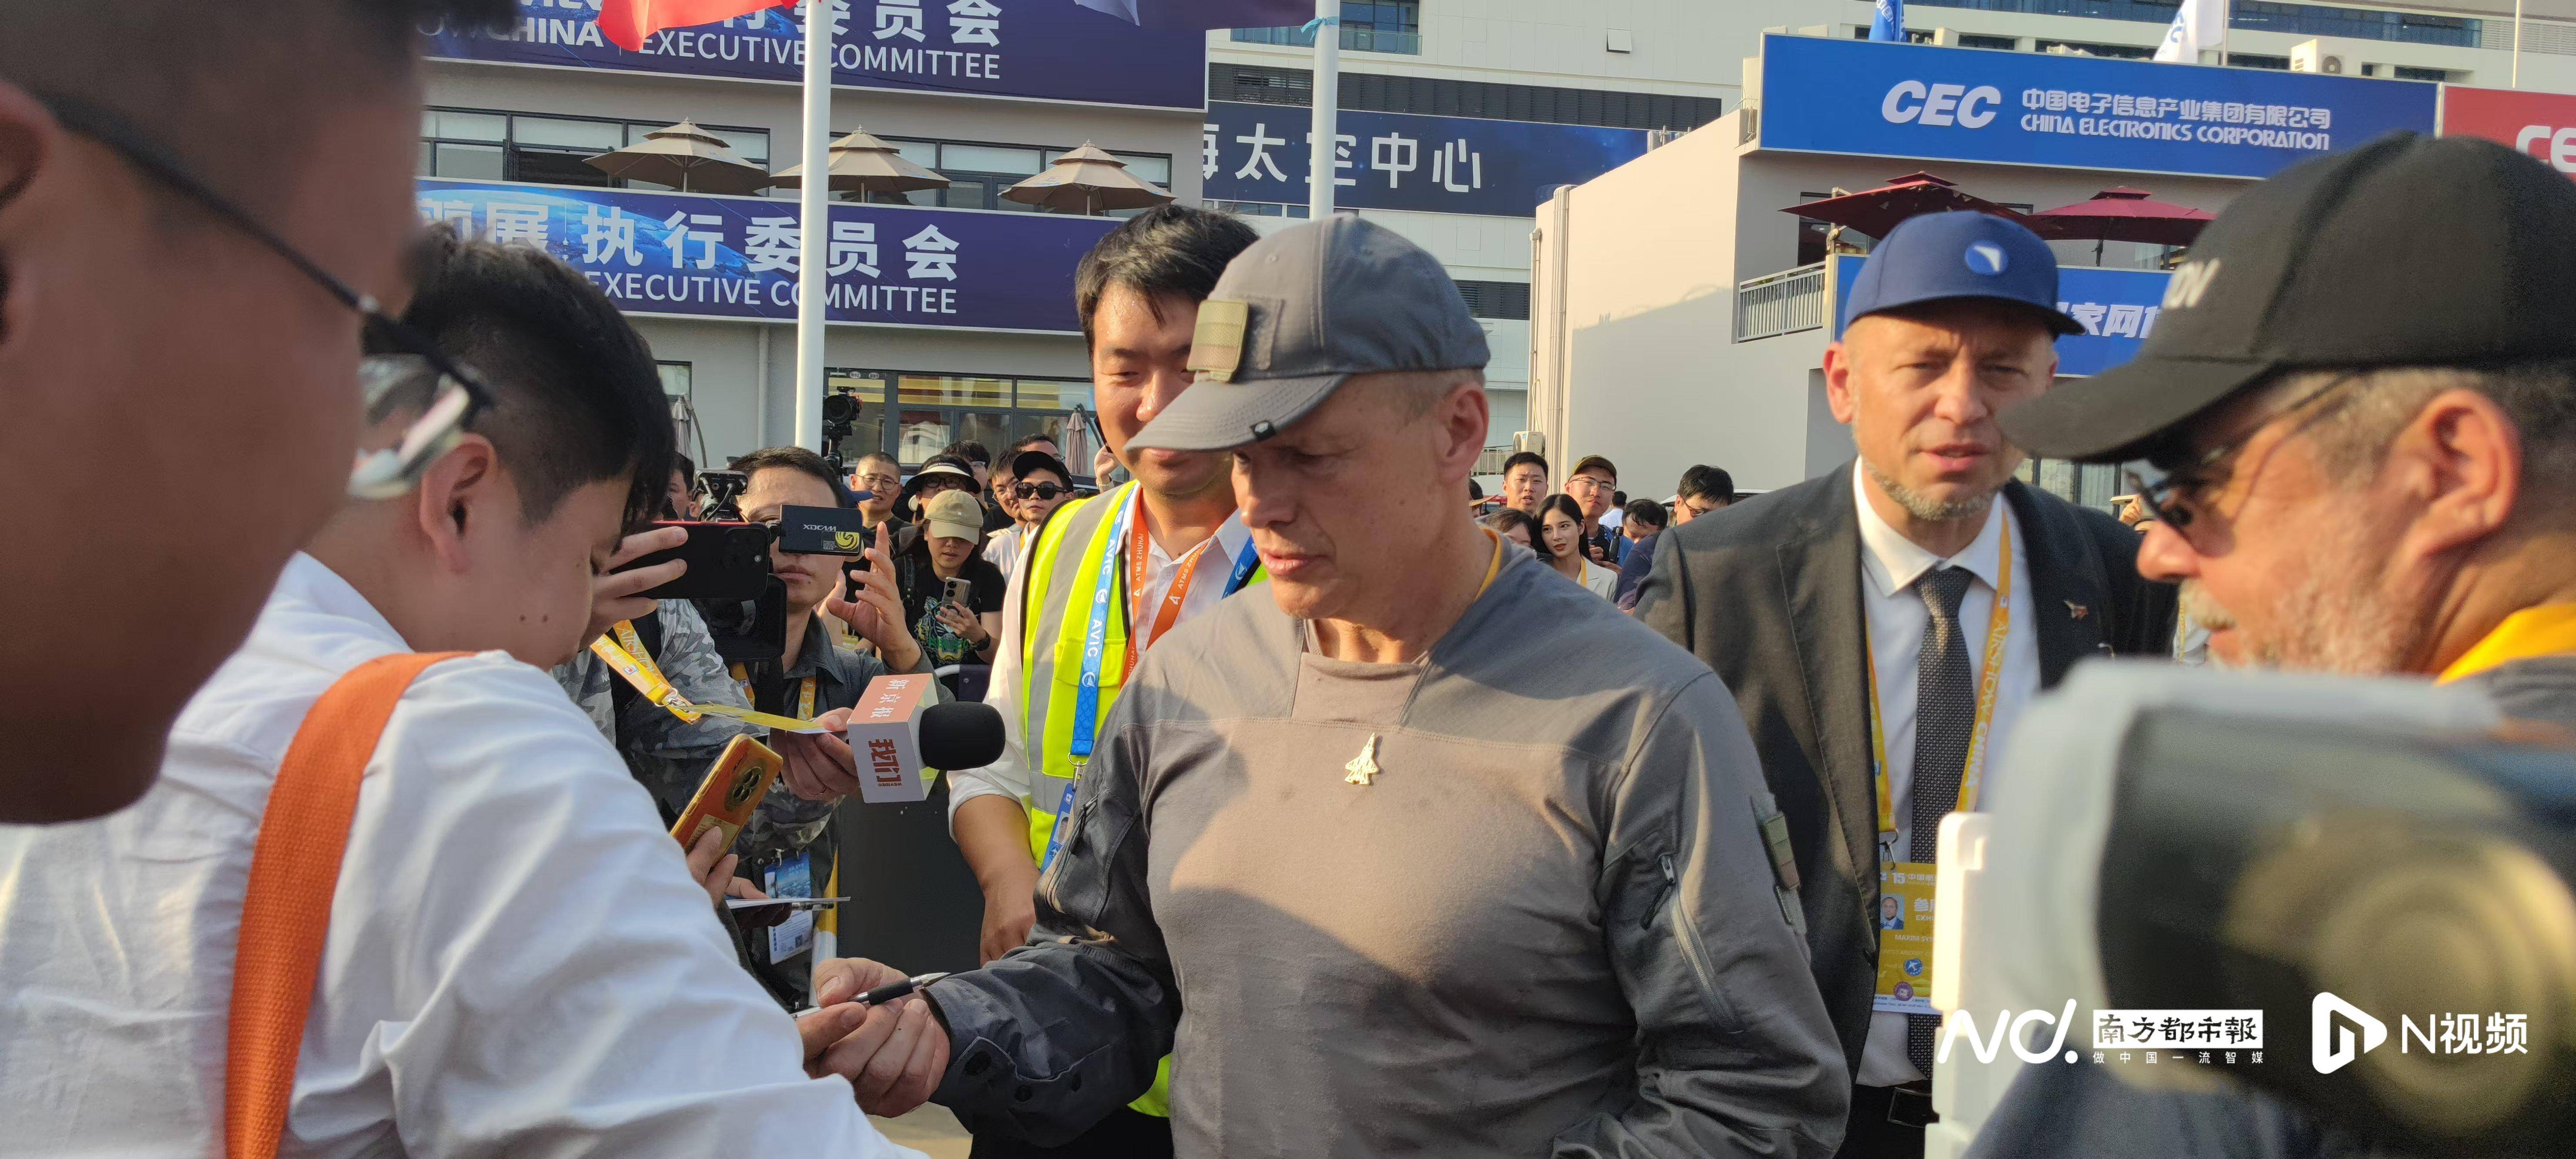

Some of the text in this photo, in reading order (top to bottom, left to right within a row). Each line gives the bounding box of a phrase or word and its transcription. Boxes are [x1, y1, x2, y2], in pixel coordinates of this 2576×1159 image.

[1882, 80, 2001, 128] CEC
[2022, 88, 2331, 130] 中国电子信息产业集团有限公司
[2021, 114, 2329, 150] CHINA ELECTRONICS CORPORATION
[1102, 539, 1115, 575] AVIC
[1177, 568, 1189, 590] ATMS
[1087, 619, 1103, 658] AVIC
[870, 679, 909, 718] 新京报
[869, 739, 902, 782] 我们
